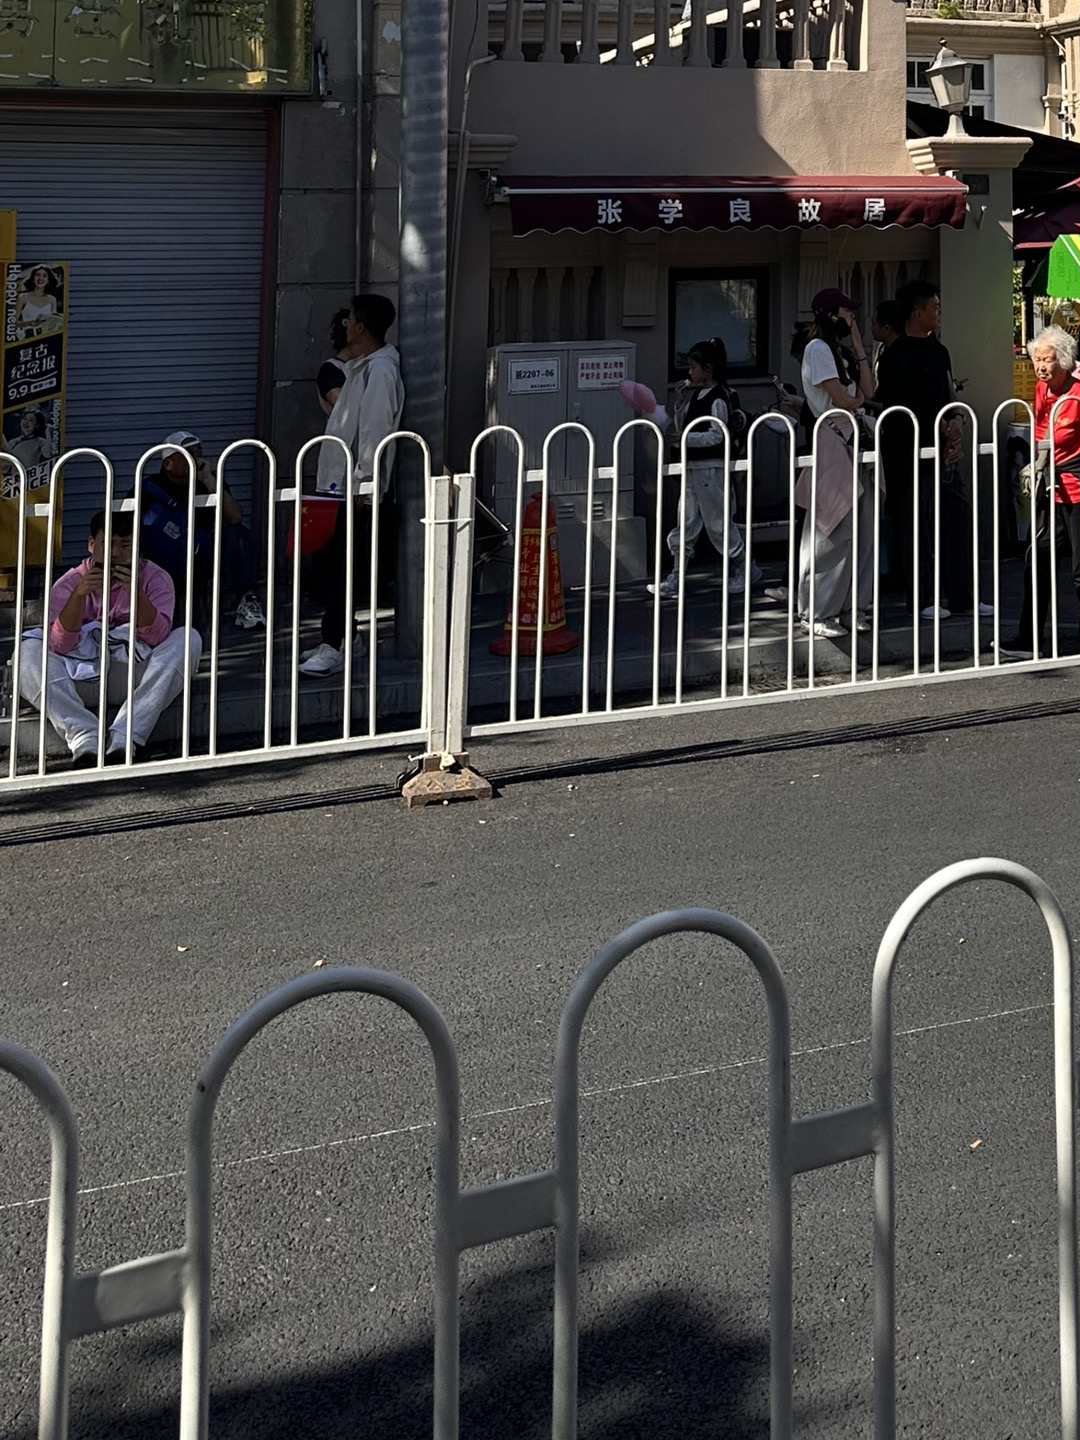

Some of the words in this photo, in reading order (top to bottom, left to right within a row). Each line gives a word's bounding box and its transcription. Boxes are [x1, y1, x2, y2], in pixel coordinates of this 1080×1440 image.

[596, 198, 886, 225] 张学良故居
[5, 264, 21, 306] Happy
[7, 308, 17, 342] news
